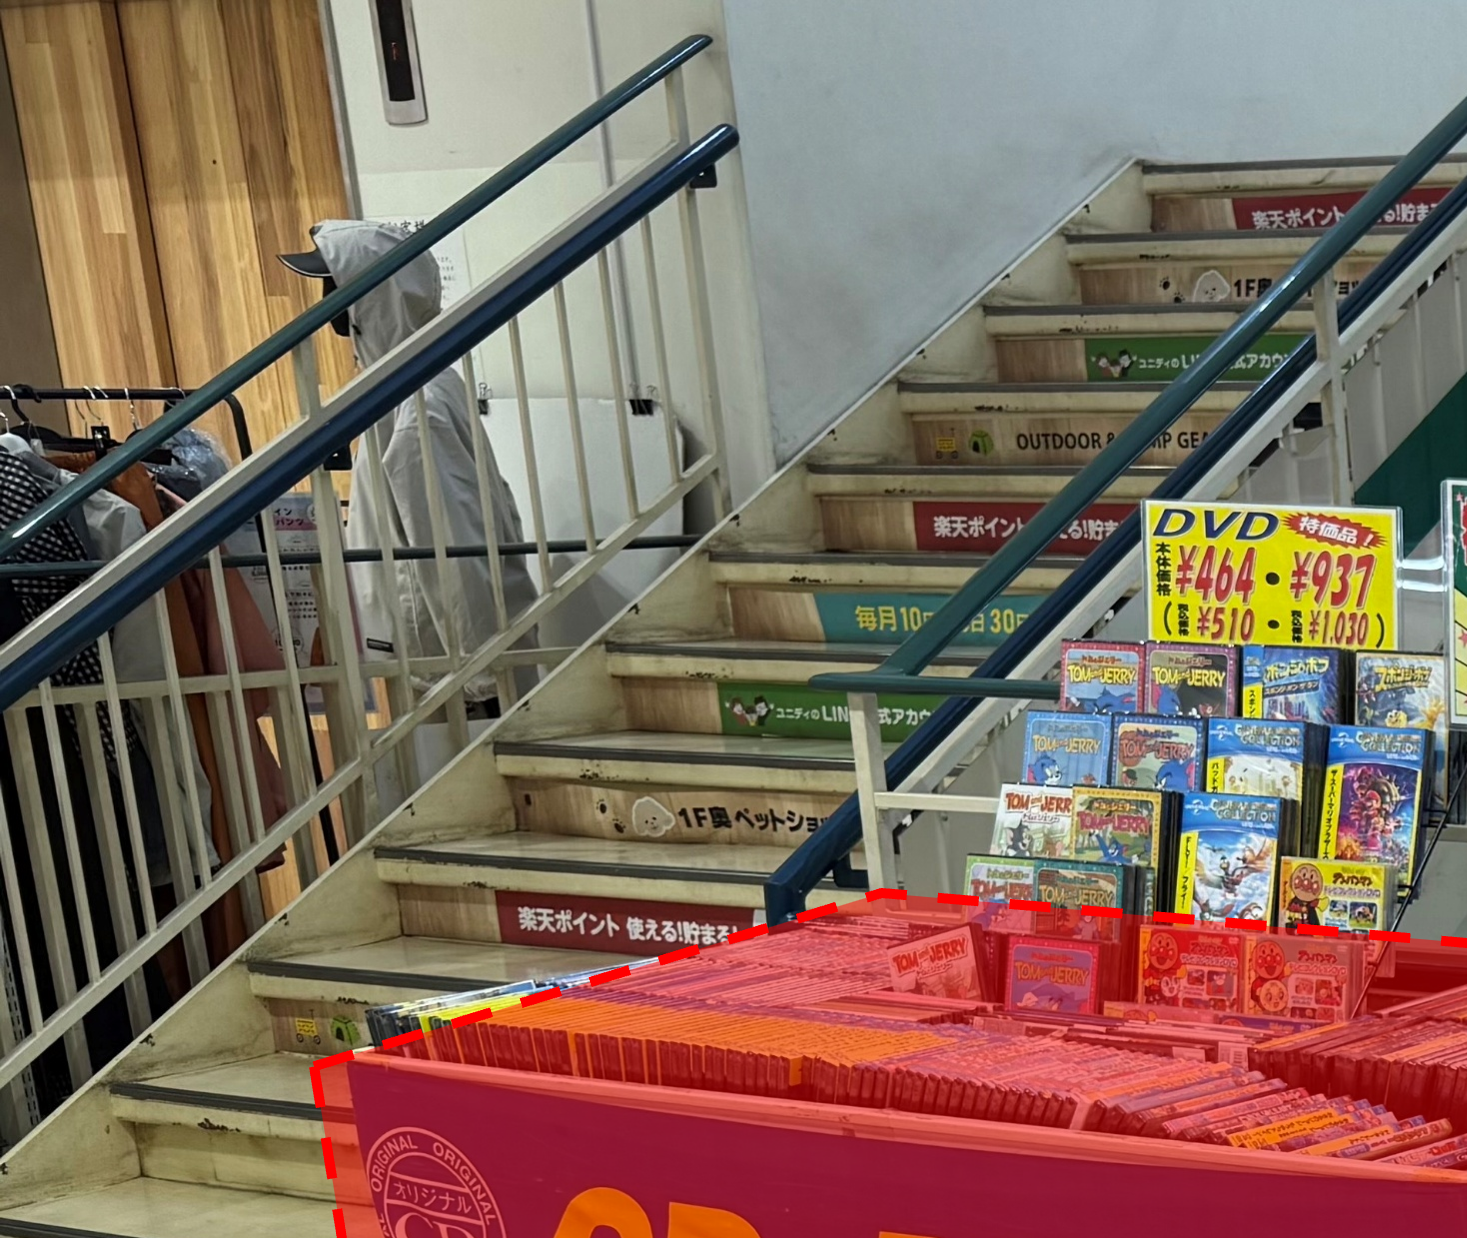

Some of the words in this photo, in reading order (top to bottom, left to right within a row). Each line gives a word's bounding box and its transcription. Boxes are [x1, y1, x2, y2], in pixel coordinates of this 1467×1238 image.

[1251, 204, 1345, 231] 楽天ポイント
[1016, 431, 1102, 450] OUTDOOR
[933, 514, 1024, 539] 楽天ポイント
[1152, 508, 1280, 541] DVD
[1299, 515, 1373, 547] 特価品!
[1155, 542, 1172, 597] 本体価格
[1067, 665, 1092, 683] TOM
[1100, 667, 1137, 685] JERRY
[1152, 667, 1179, 685] TOM
[1188, 669, 1226, 688] JERRY
[1032, 735, 1059, 753] TOM
[1065, 737, 1102, 755] JERRY
[1005, 792, 1031, 811] TOM
[1041, 796, 1073, 813] JERR
[677, 806, 732, 830] 1F奥
[1039, 885, 1065, 905] TOM
[1075, 887, 1115, 907] JERRY
[518, 906, 620, 934] 楽天ポイント
[892, 952, 918, 974] TOM
[928, 937, 968, 963] JERRY
[1015, 961, 1041, 981] TOM
[1051, 964, 1089, 985] JERRY
[392, 1178, 471, 1217] オリジナル
